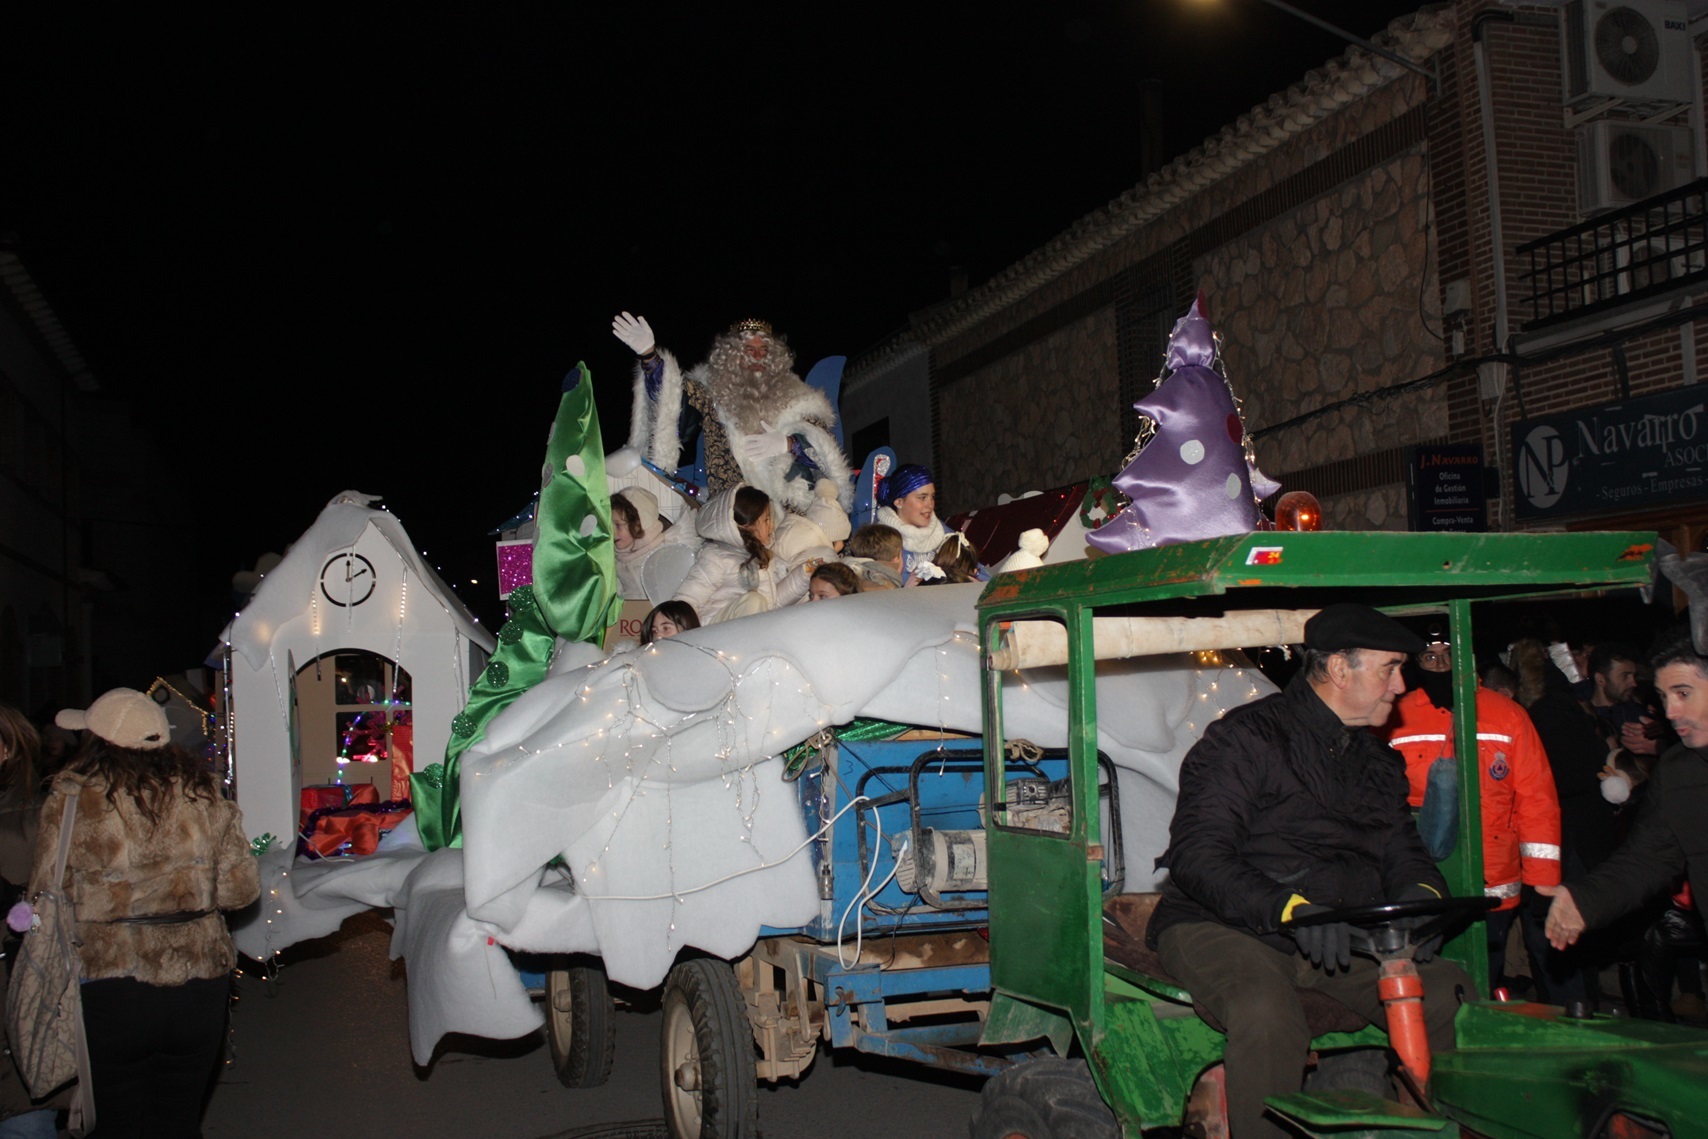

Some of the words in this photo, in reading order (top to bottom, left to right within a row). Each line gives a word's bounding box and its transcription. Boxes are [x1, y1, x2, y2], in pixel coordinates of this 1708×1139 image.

[1664, 20, 1686, 31] BAXI
[1574, 404, 1704, 460] Navarro
[1439, 471, 1461, 480] Oficina
[1435, 484, 1443, 493] de
[1601, 485, 1643, 501] Seguros
[1650, 475, 1703, 494] Empresas
[1434, 496, 1470, 505] Inmobiliaria
